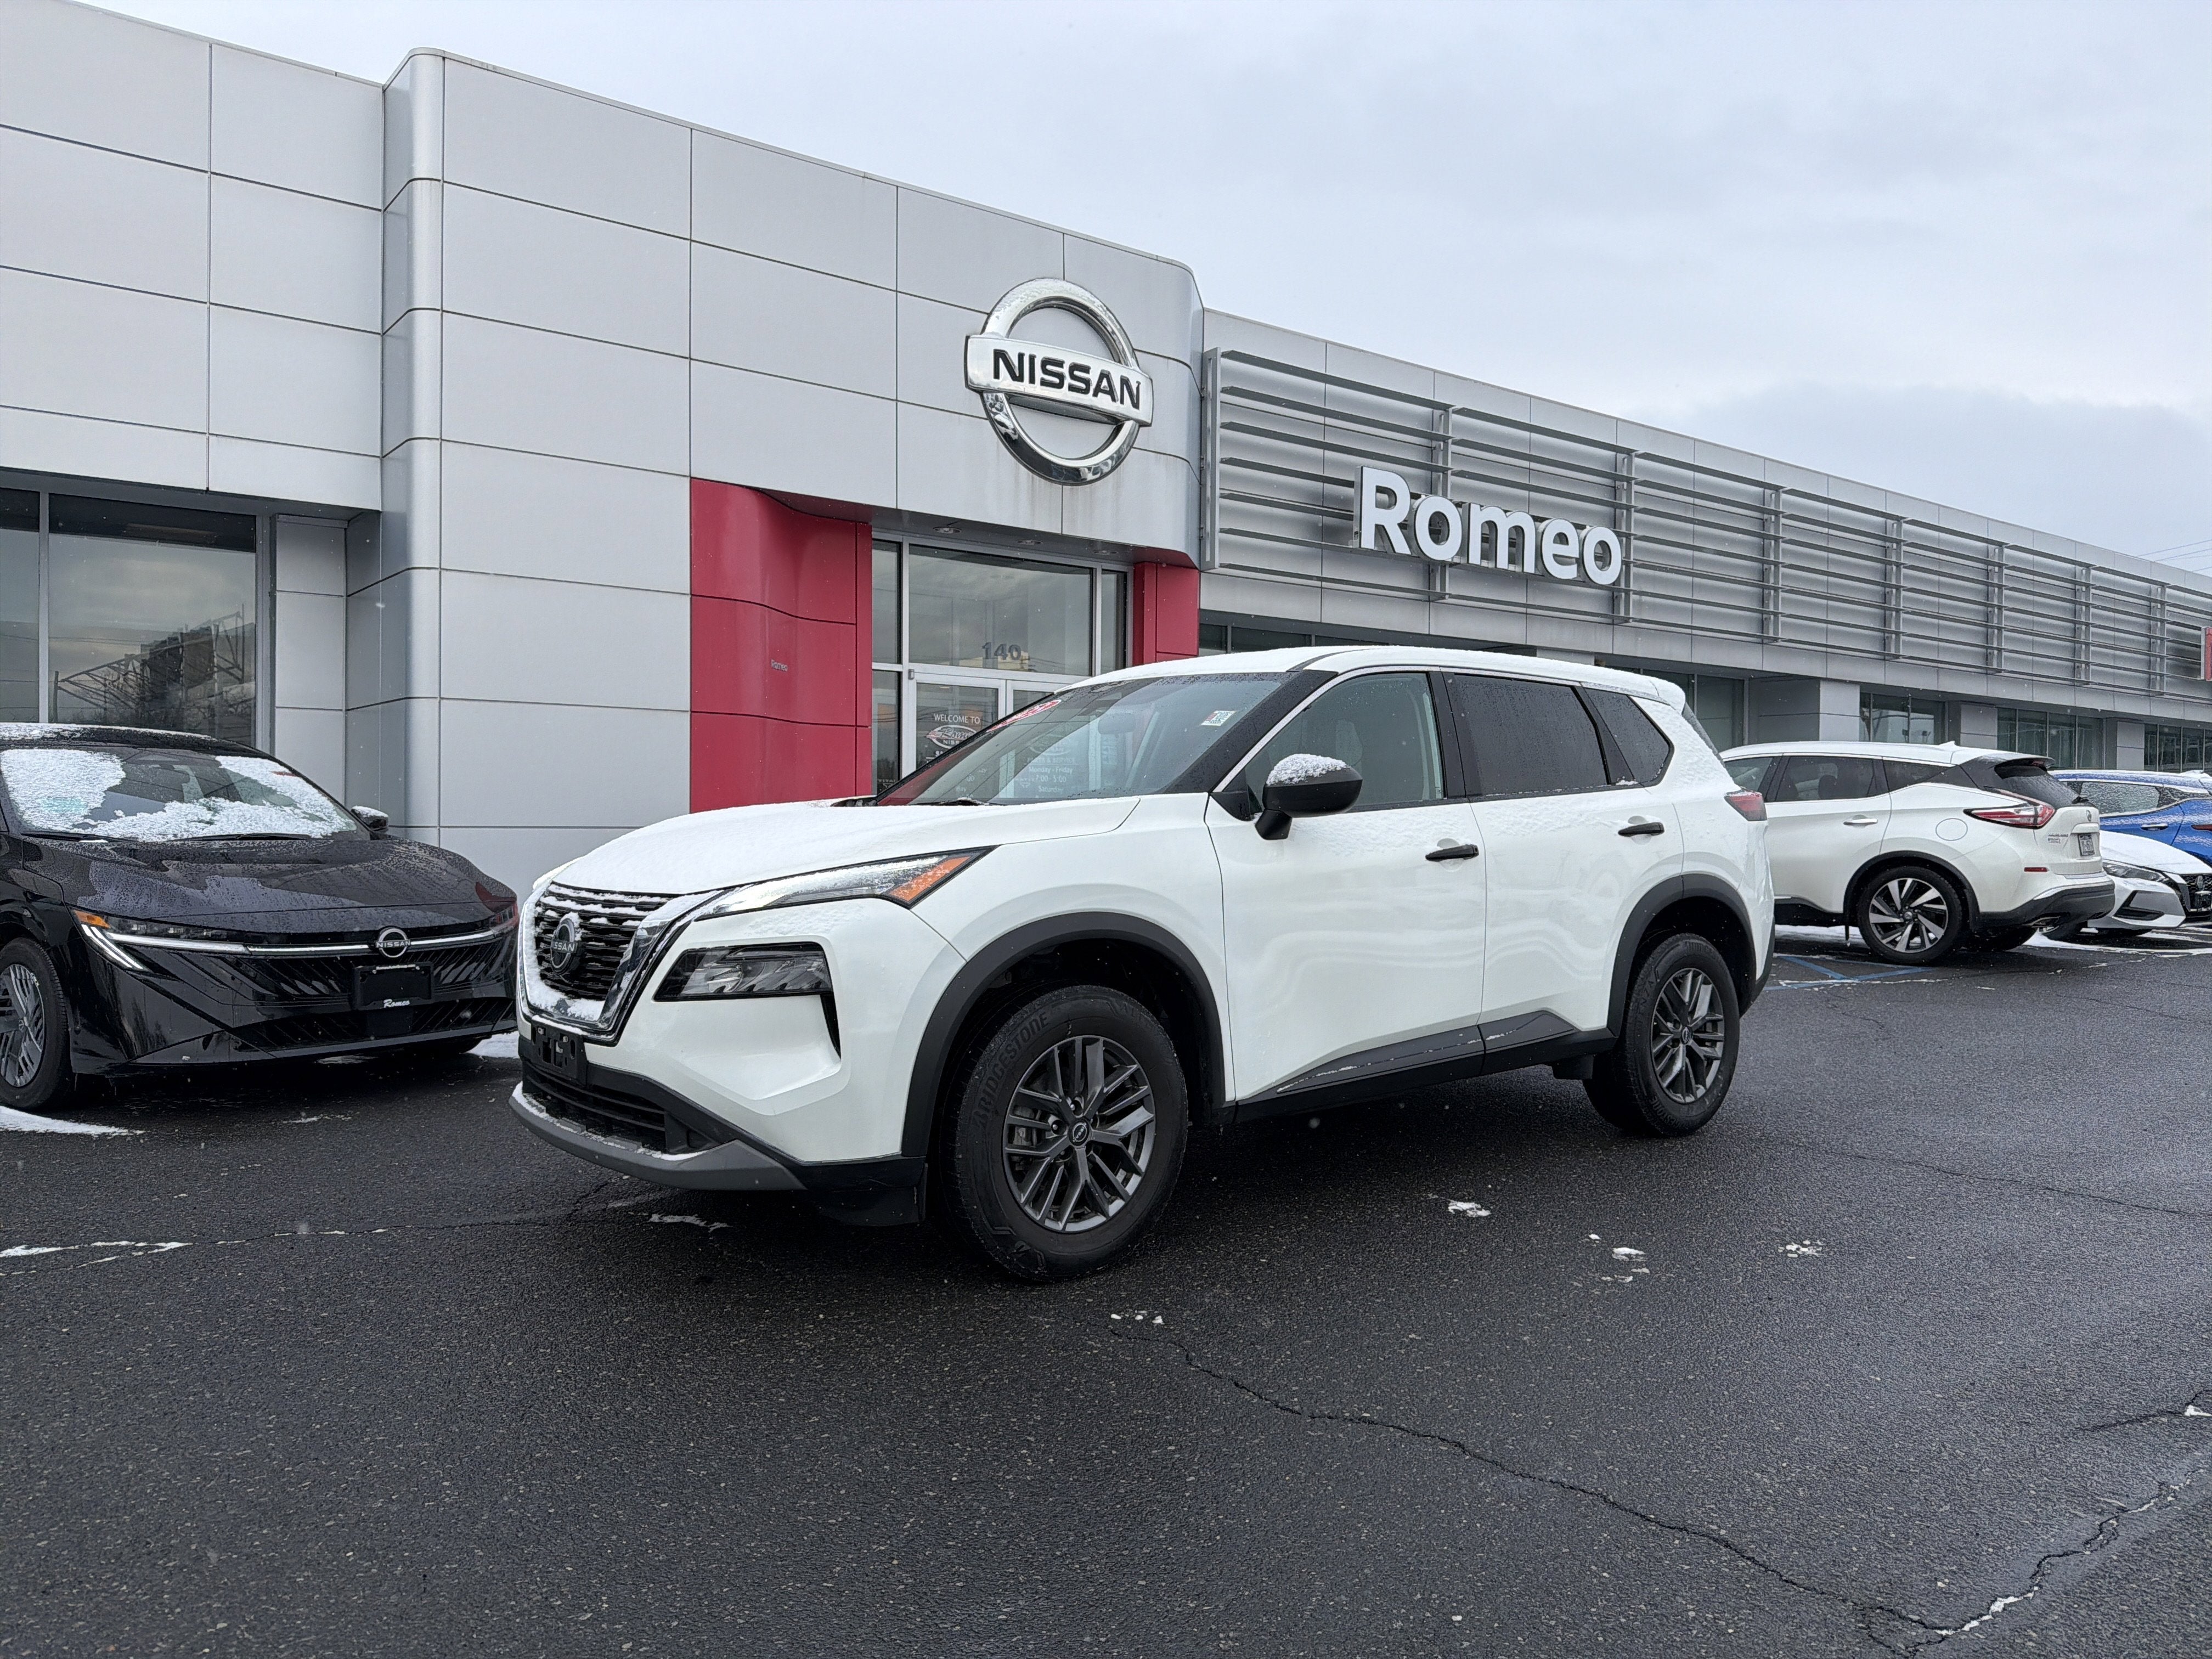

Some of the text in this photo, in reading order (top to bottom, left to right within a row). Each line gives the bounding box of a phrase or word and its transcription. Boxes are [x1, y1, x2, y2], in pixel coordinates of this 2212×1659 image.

[993, 349, 1141, 410] NISSAN
[1355, 465, 1622, 585] Romeo
[982, 642, 1021, 661] 140
[771, 658, 788, 672] Romeo
[934, 713, 980, 724] WELCOME TO
[1038, 786, 1064, 794] Saturday
[383, 998, 410, 1008] Romeo
[972, 1011, 1049, 1131] BRIDGESTONE
